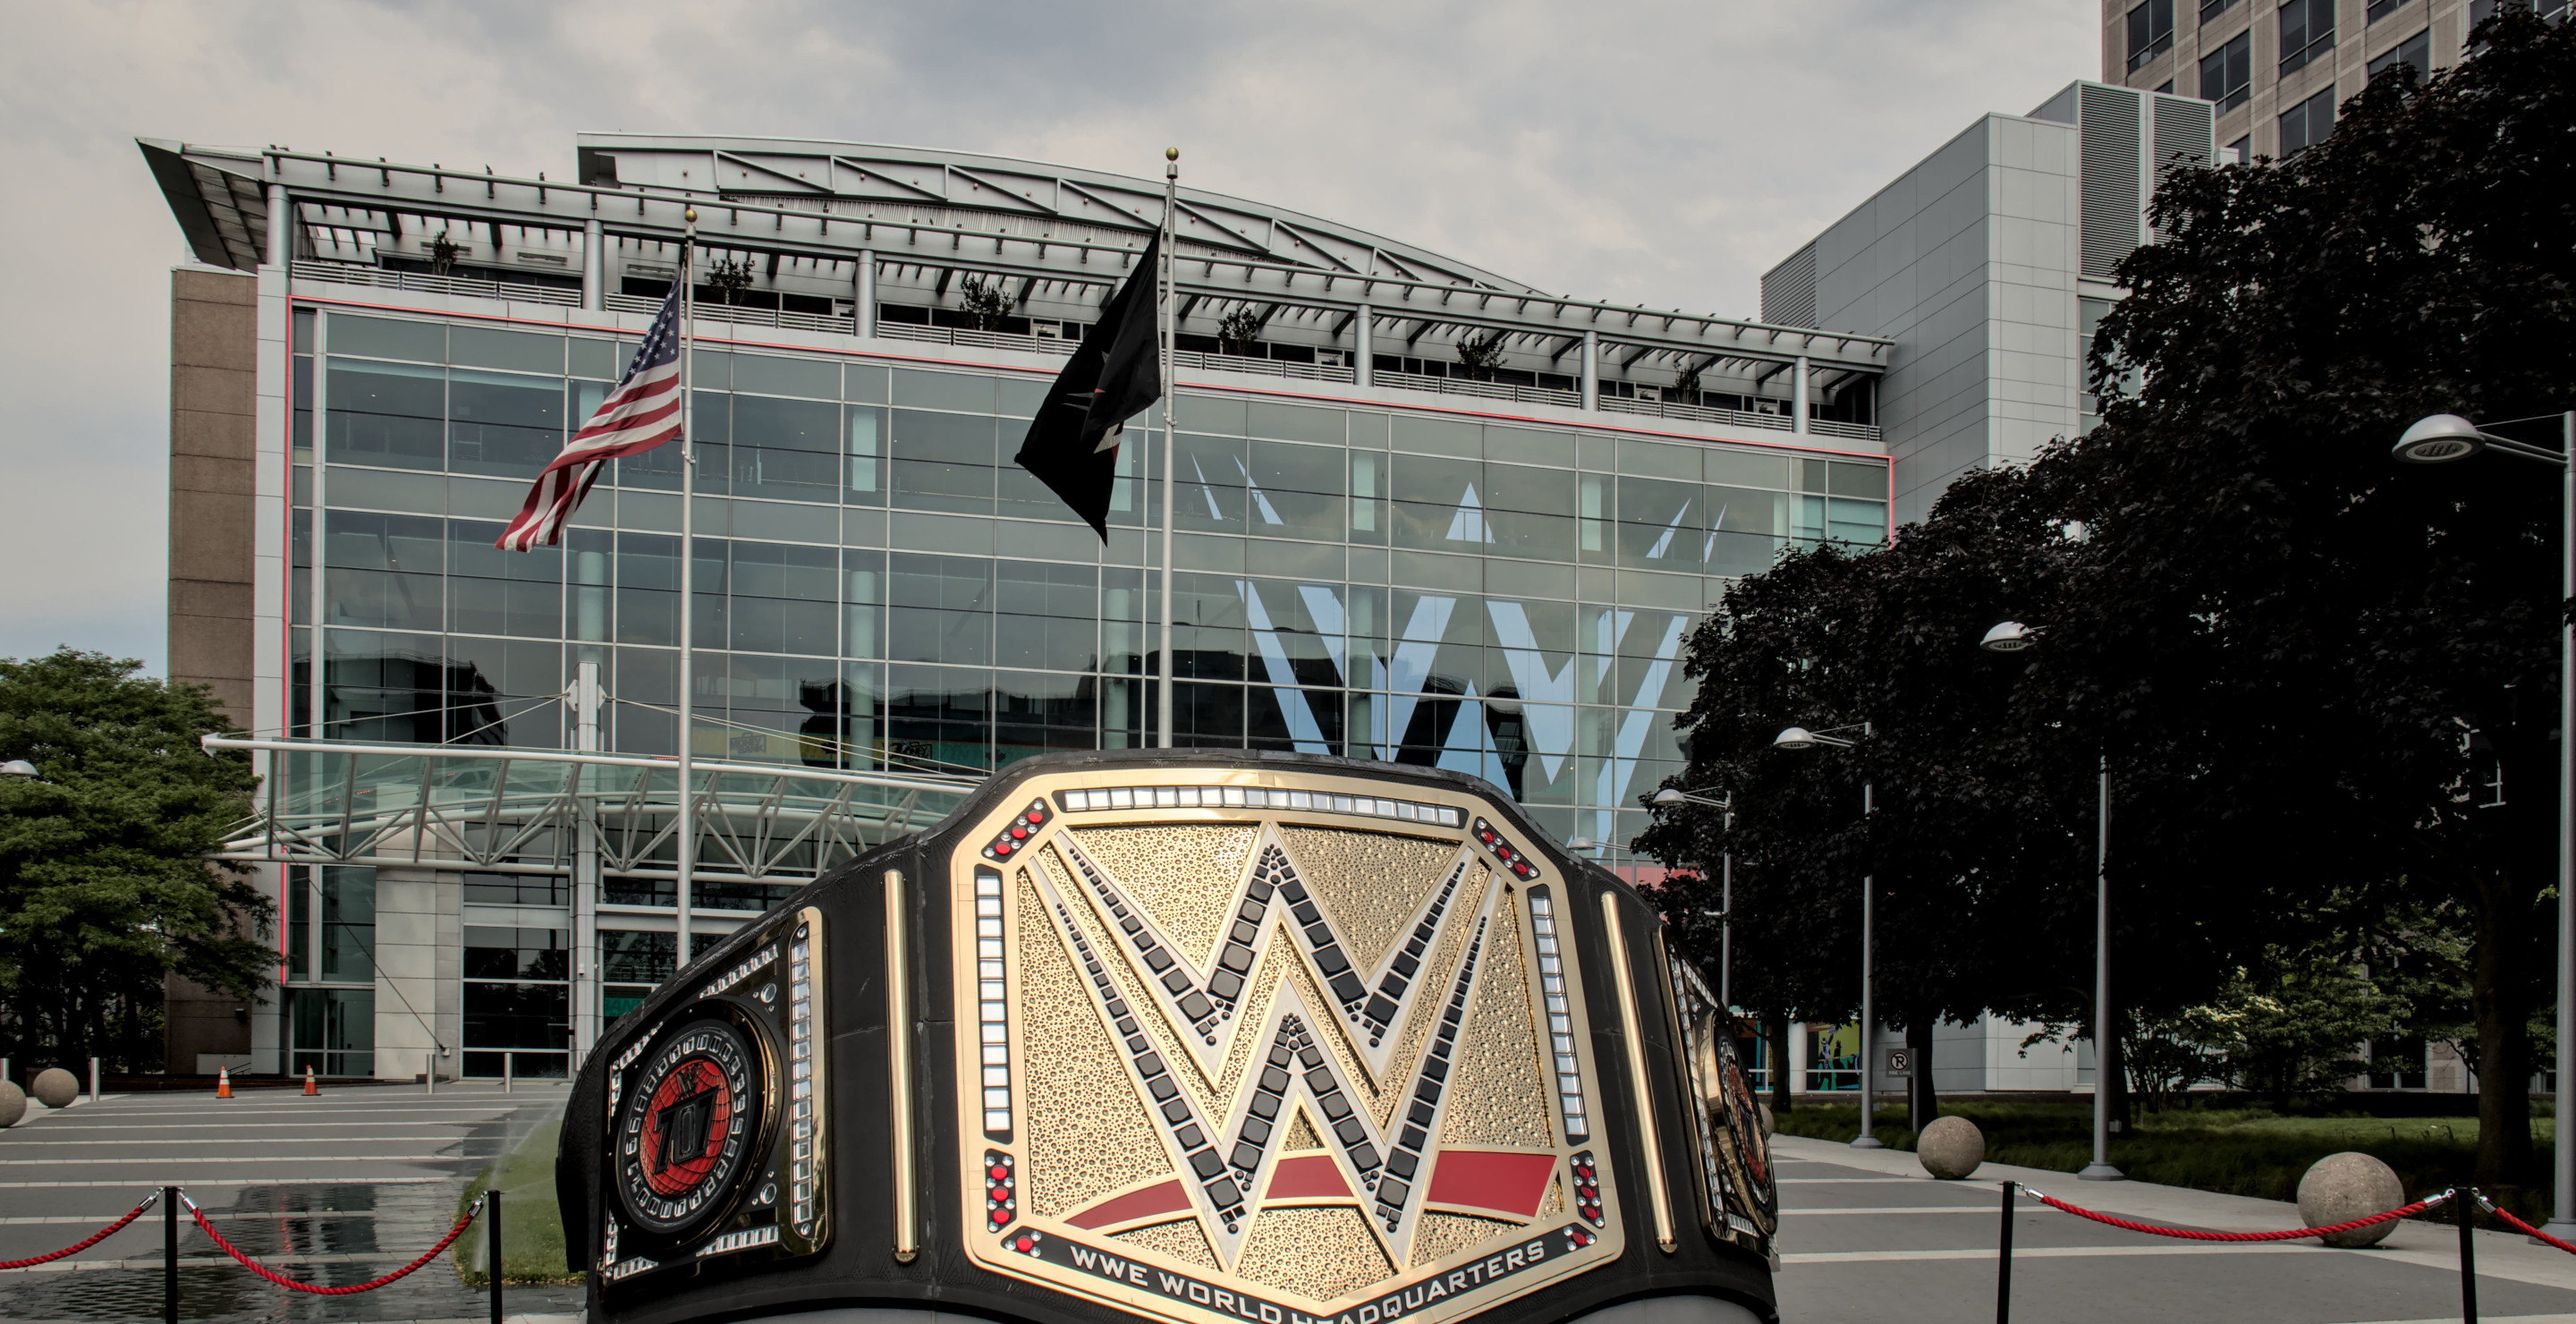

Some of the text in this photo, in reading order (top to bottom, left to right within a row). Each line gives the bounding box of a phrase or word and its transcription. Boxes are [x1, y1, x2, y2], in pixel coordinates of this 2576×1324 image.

[1070, 1240, 1545, 1324] WWE WORLD HADQUARTERS
